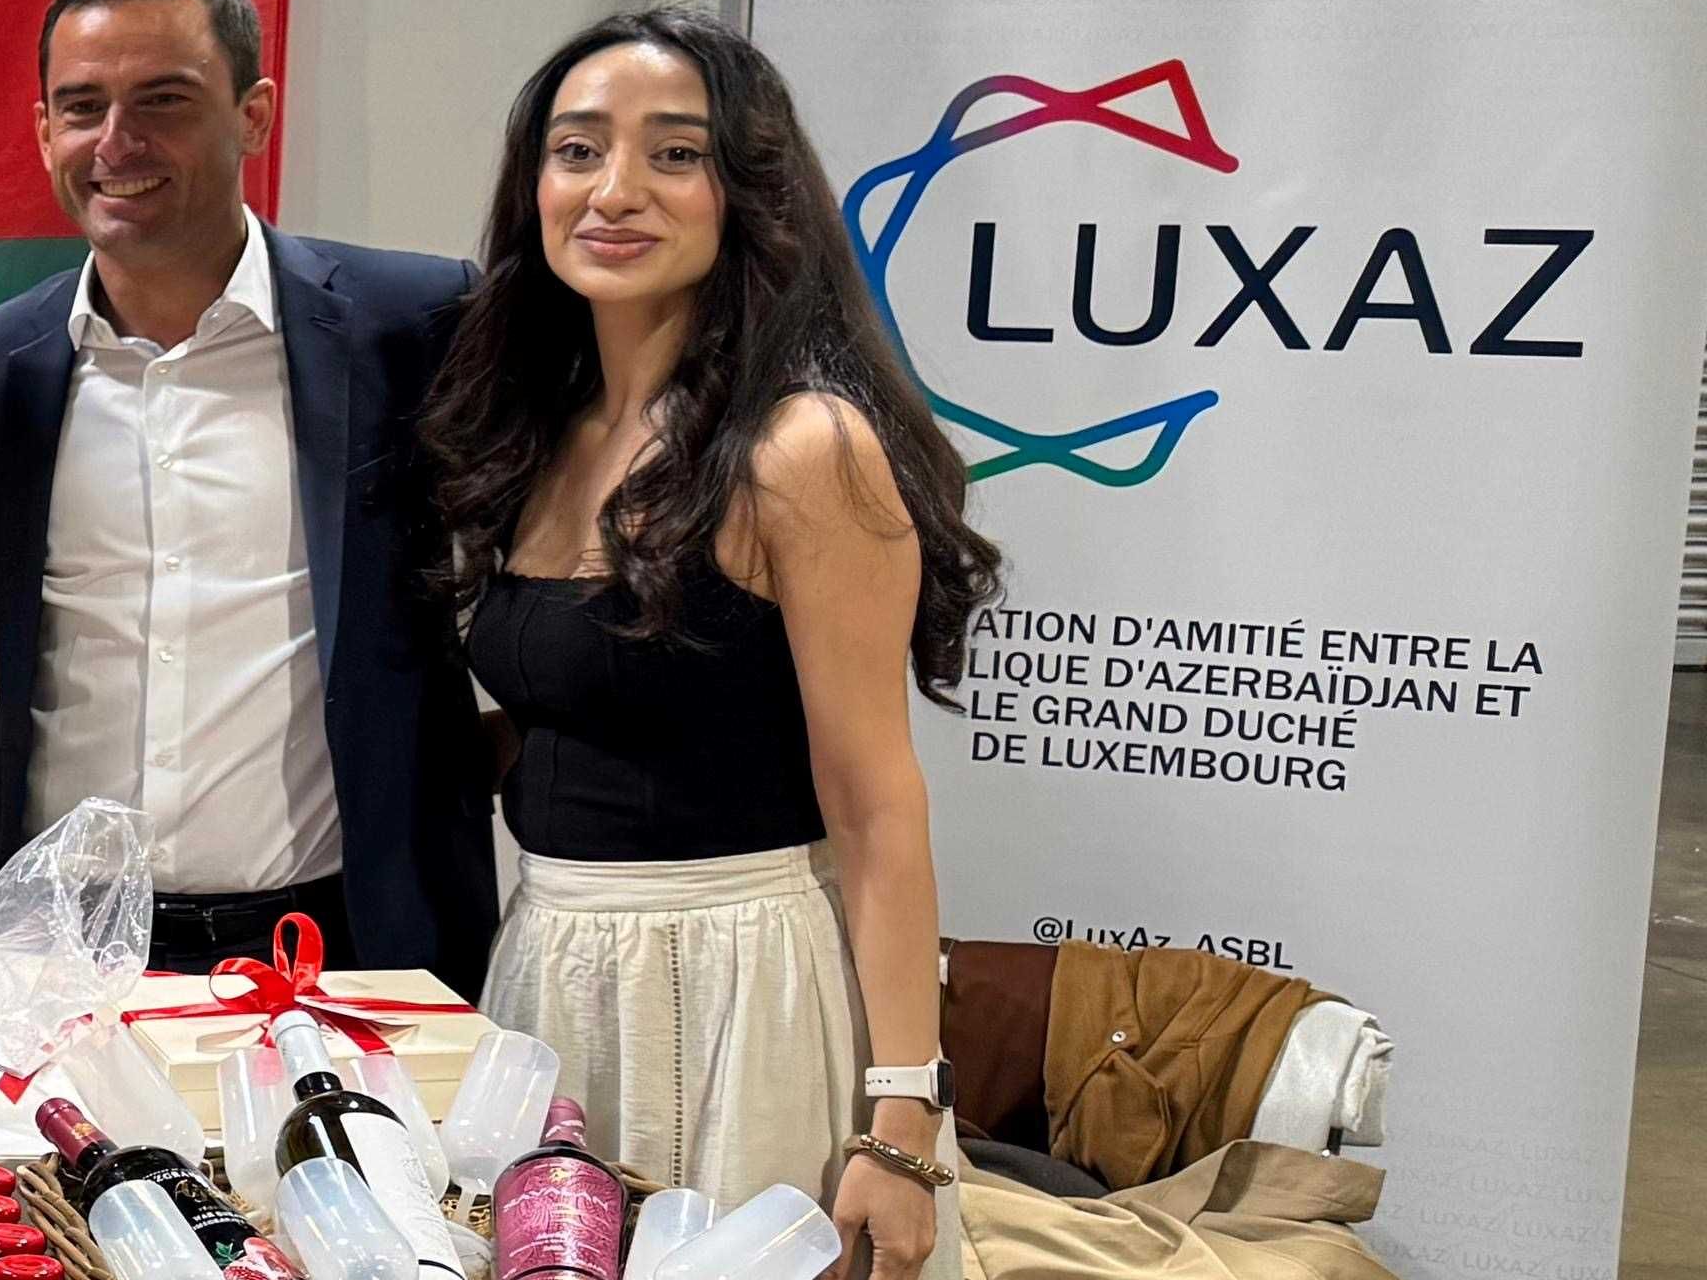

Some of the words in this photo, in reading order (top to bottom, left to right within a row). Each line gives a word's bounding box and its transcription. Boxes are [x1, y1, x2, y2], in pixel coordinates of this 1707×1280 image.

[966, 221, 1595, 359] LUXAZ
[971, 608, 1096, 644] ATION
[1113, 615, 1304, 658] D'AMITIÉ
[1320, 630, 1470, 670] ENTRE
[1487, 640, 1543, 674] LA
[968, 648, 1088, 688] LIQUE
[1104, 657, 1457, 712] D'AZERBAÏDJAN
[1475, 684, 1531, 717] ET
[970, 690, 1016, 722] LE
[1032, 695, 1187, 734] GRAND
[1203, 710, 1357, 749] DUCHÉ
[971, 734, 1026, 763] DE
[1041, 738, 1347, 791] LUXEMBOURG
